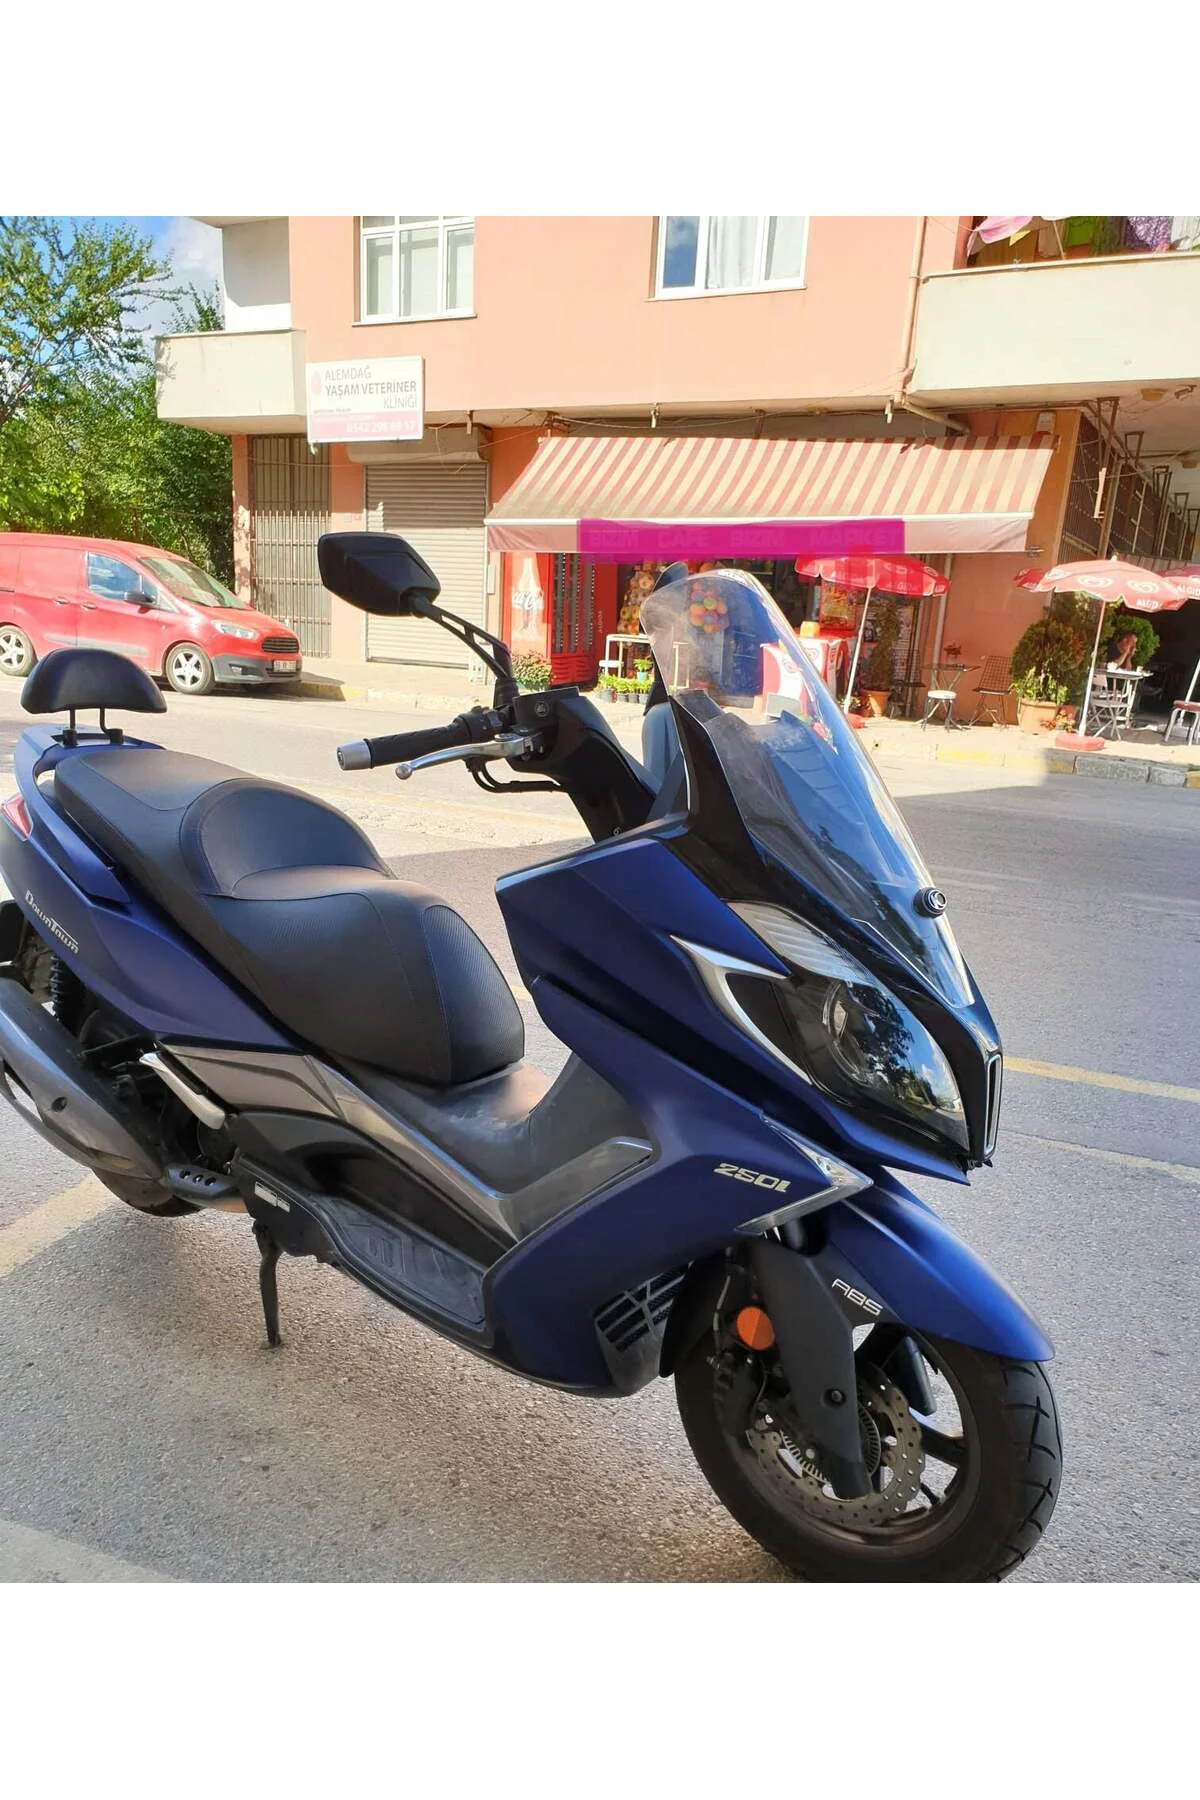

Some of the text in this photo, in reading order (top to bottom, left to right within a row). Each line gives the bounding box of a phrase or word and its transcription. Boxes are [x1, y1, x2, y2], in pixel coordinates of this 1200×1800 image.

[325, 365, 372, 381] ALEMDAĞ
[325, 379, 417, 399] YAŞAM VETERİNER
[832, 1278, 883, 1317] ABS
